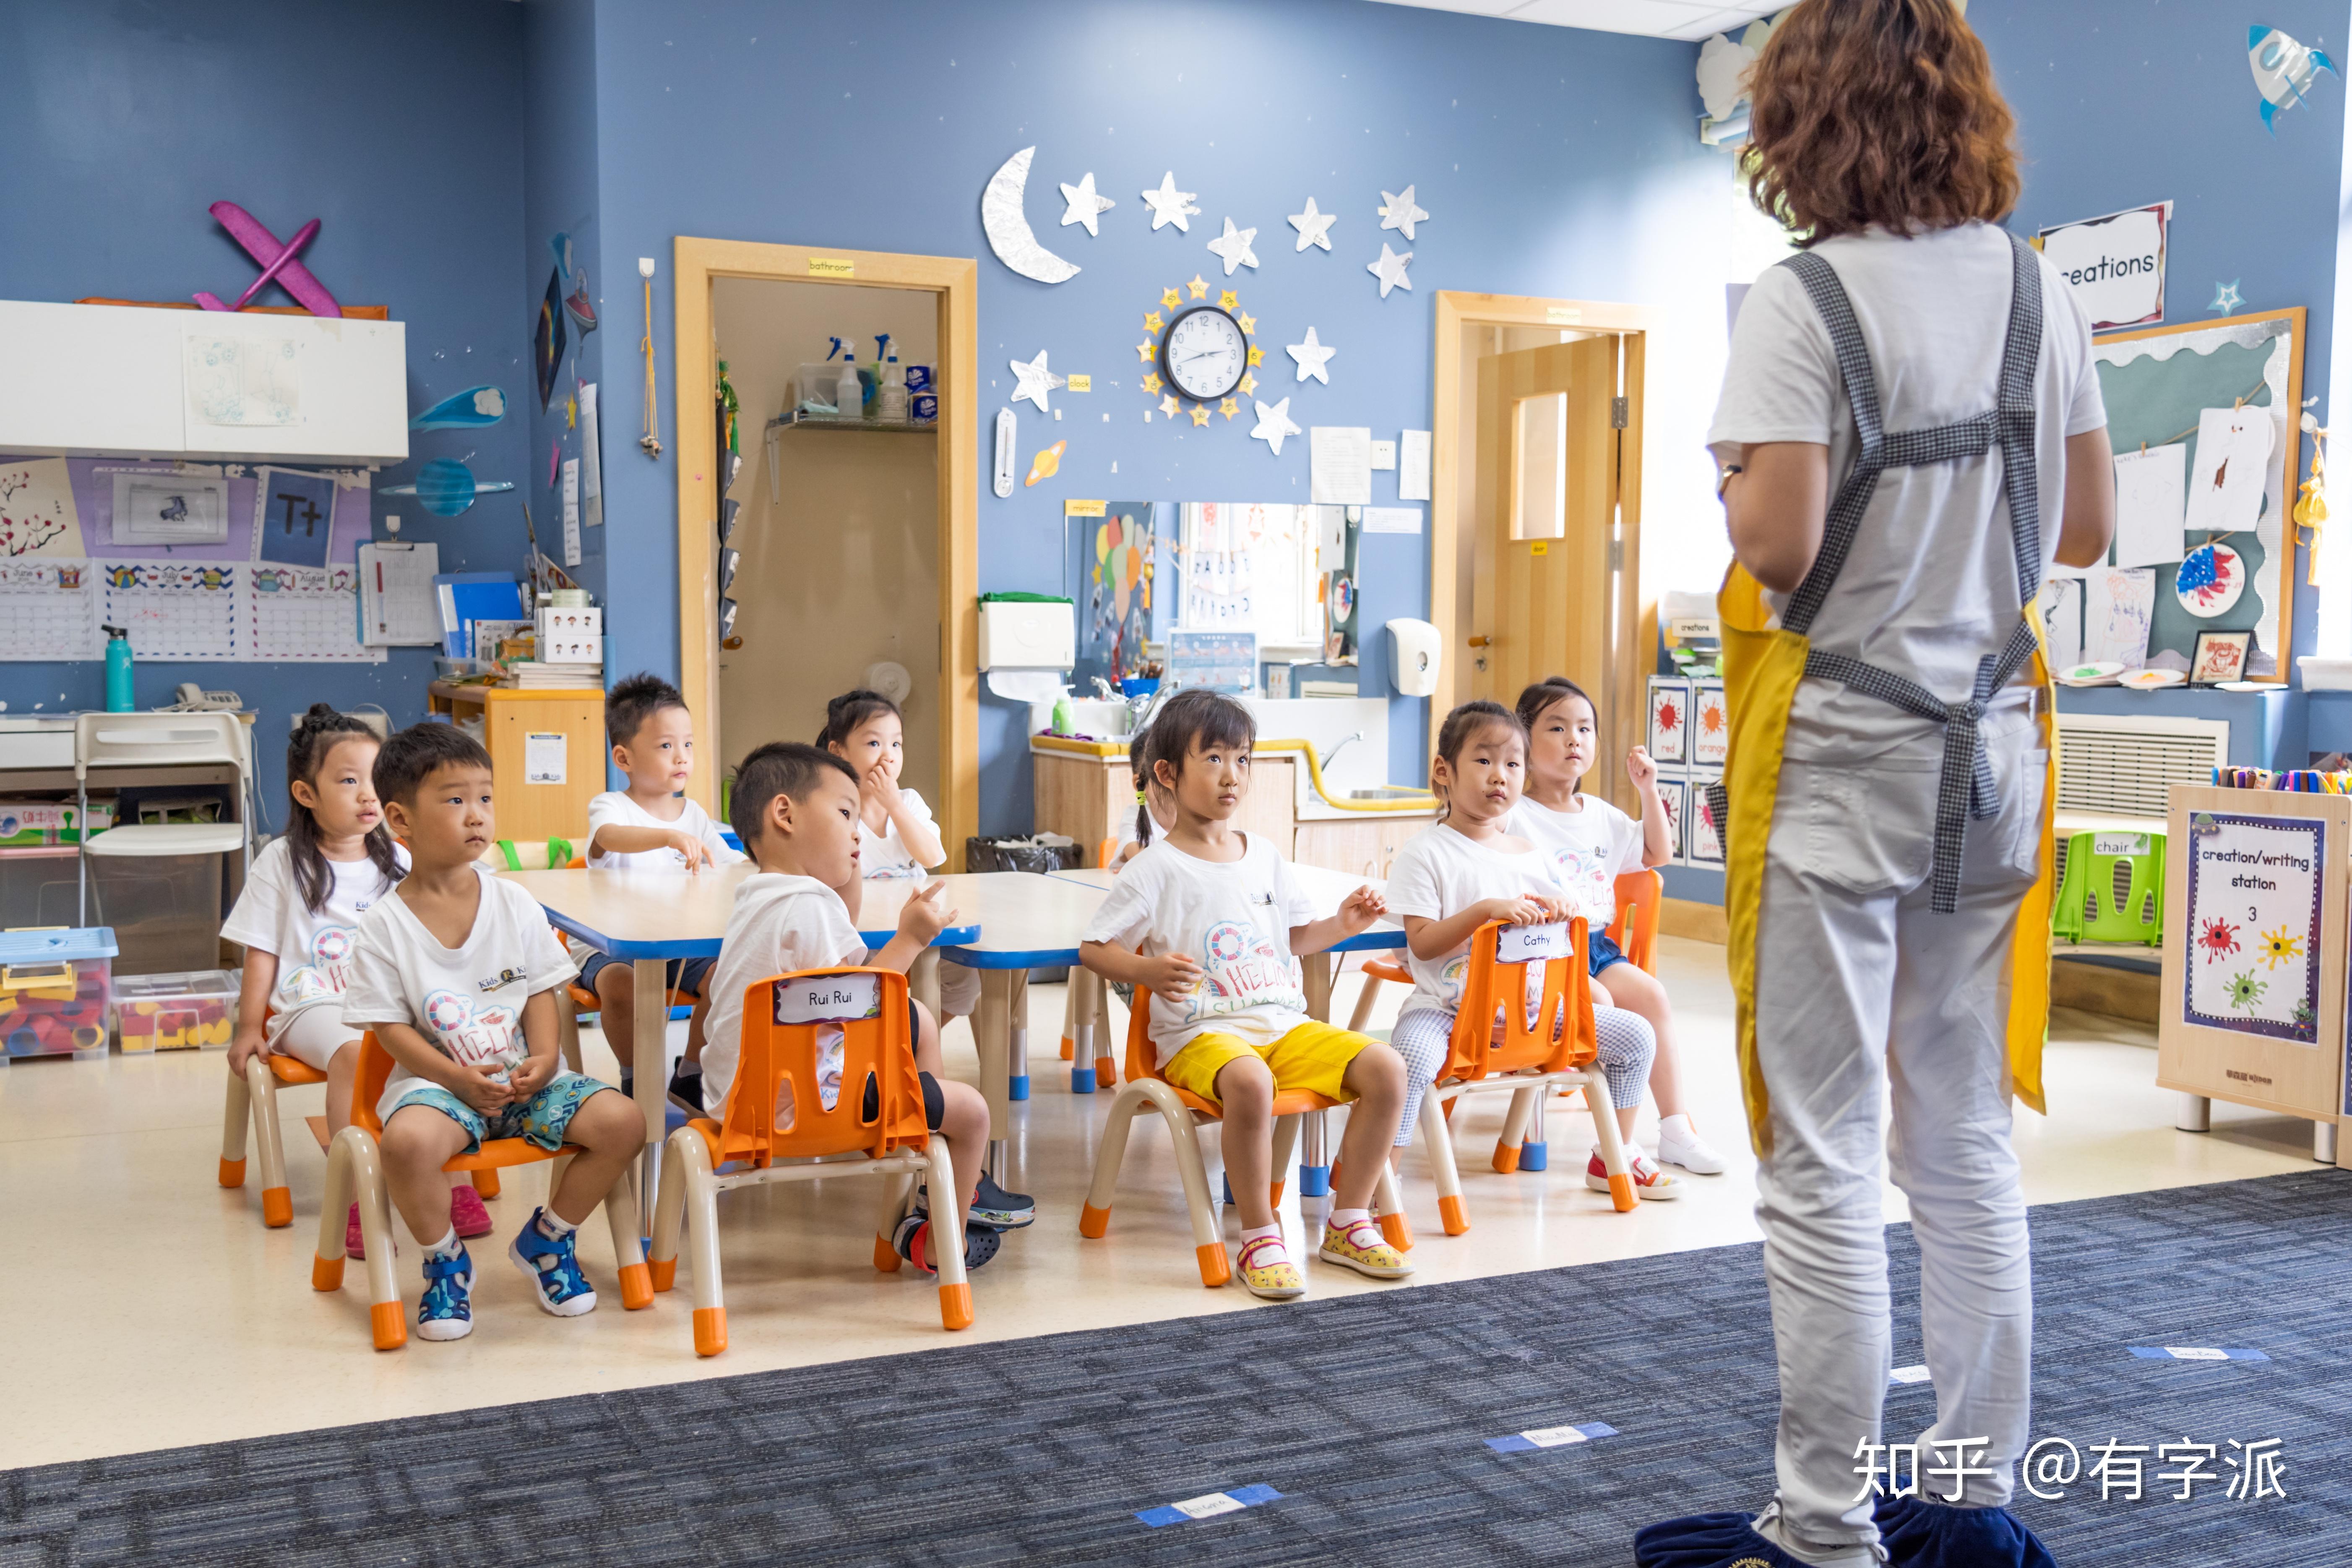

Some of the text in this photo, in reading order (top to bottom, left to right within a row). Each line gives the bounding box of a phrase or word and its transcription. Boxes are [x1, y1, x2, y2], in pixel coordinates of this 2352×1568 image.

[2062, 255, 2154, 285] eations
[1185, 321, 1194, 331] 11
[1199, 316, 1209, 326] 12
[1216, 322, 1220, 332] 1
[1175, 333, 1184, 344] 10
[1227, 334, 1233, 344] 2
[1172, 348, 1177, 358] 9
[1230, 349, 1236, 359] 3
[1176, 365, 1182, 375] 8
[1227, 366, 1232, 375] 4
[1070, 378, 1090, 388] clock
[1187, 377, 1193, 387] 7
[1217, 377, 1222, 388] 5
[1201, 383, 1207, 393] 6
[277, 494, 322, 537] Tt
[300, 575, 326, 583] August
[1661, 742, 1675, 753] red
[1698, 744, 1726, 756] orange
[1703, 839, 1718, 853] pink
[2096, 841, 2129, 852] chair
[2202, 849, 2310, 872] creation/writing
[2232, 874, 2276, 891] station
[2248, 906, 2257, 921] 3
[1524, 934, 1550, 946] Cathy
[479, 977, 498, 989] Kids
[809, 991, 852, 1005] Rui Rui
[820, 1087, 839, 1099] Kid
